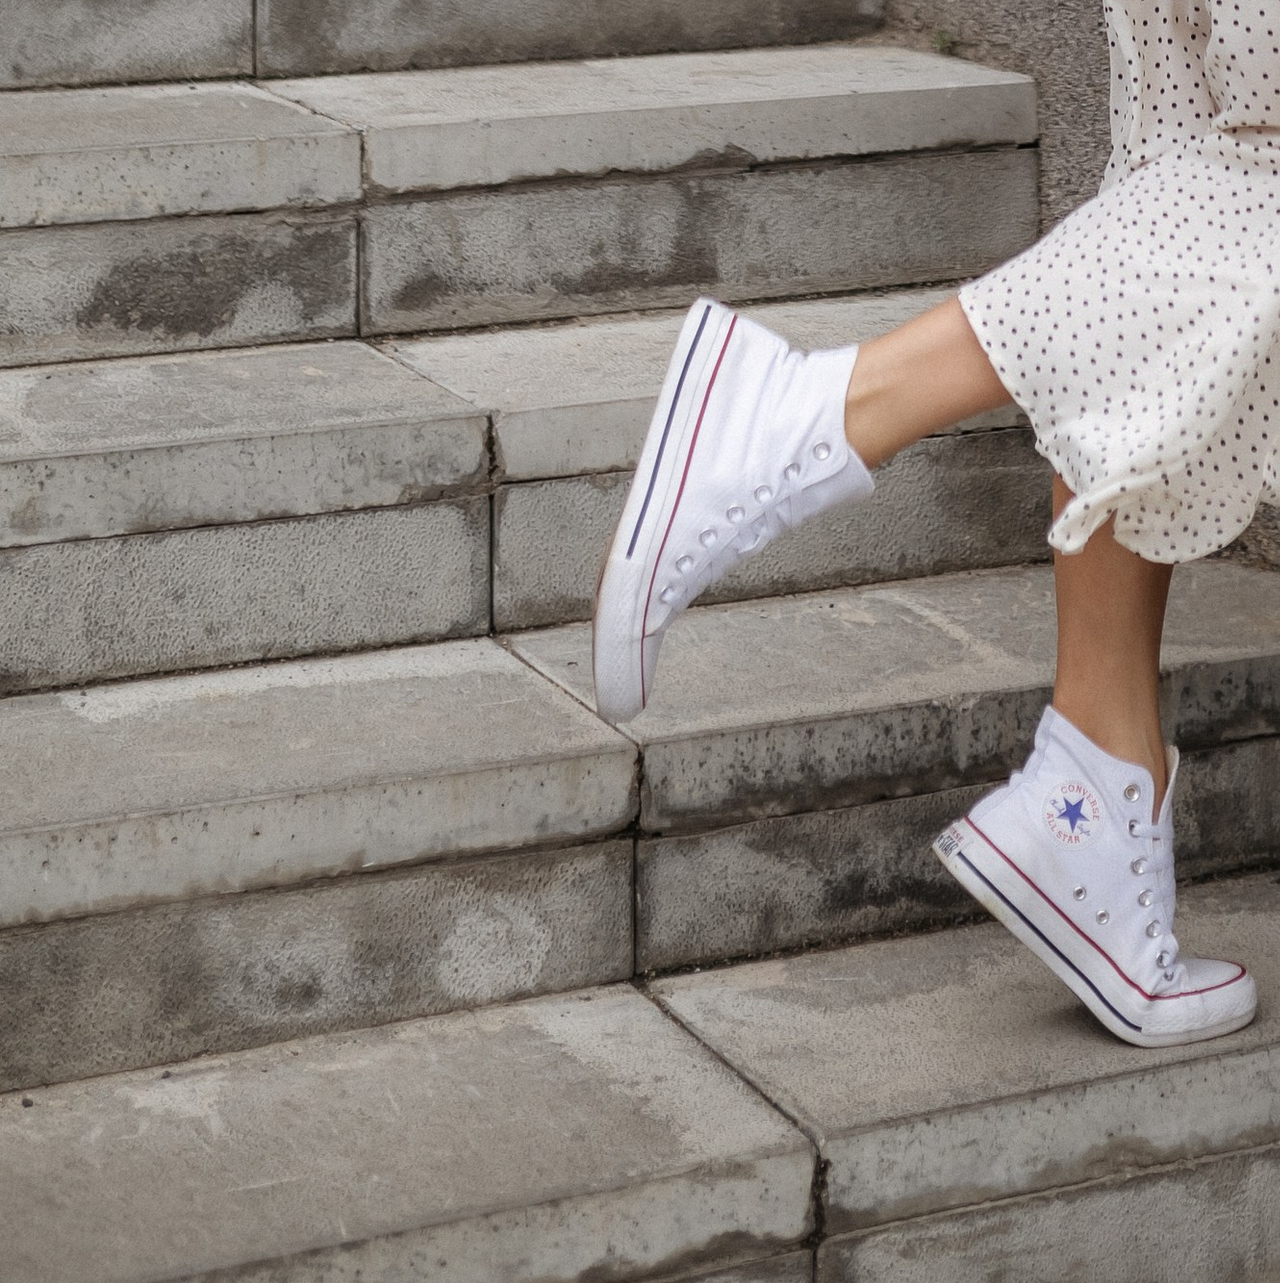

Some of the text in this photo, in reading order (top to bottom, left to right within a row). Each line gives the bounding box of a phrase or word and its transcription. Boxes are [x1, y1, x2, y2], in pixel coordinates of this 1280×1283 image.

[1060, 784, 1100, 822] CONVERSE
[1046, 812, 1057, 832] ALL
[1056, 830, 1080, 844] STAR
